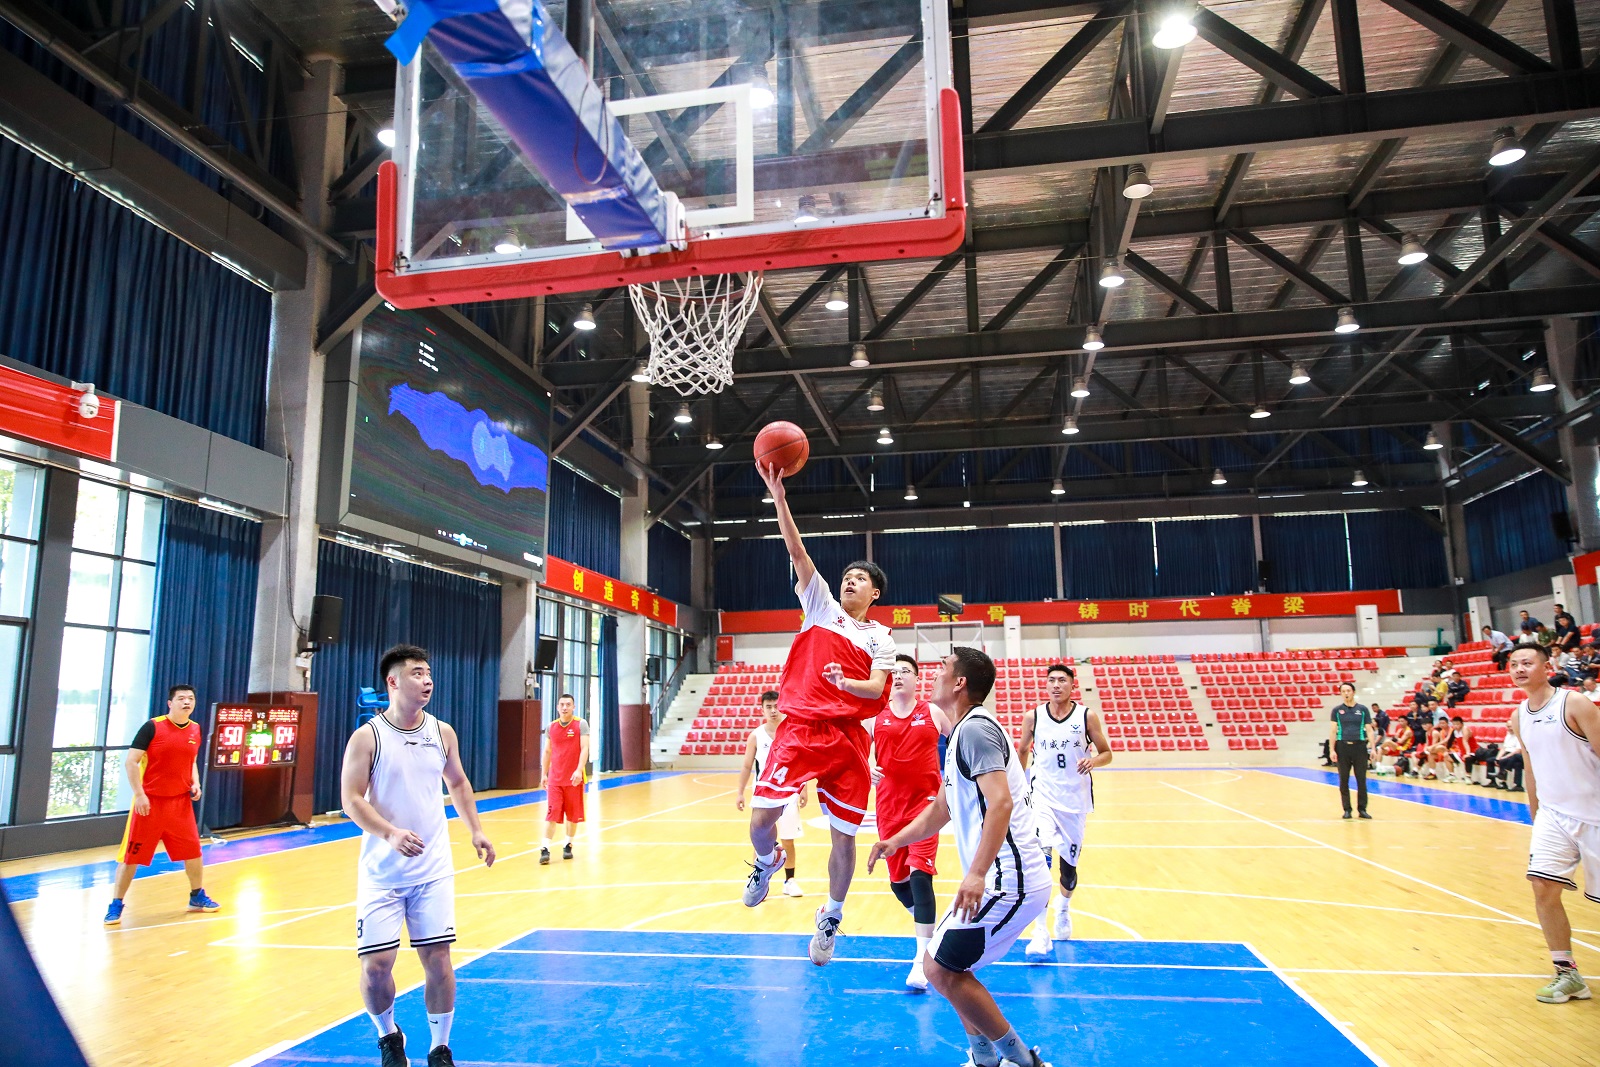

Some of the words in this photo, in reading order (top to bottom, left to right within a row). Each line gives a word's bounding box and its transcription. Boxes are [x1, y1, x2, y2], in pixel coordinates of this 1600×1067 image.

[1078, 596, 1305, 620] 铸时代脊梁
[224, 726, 243, 745] 50
[275, 726, 293, 745] 64
[247, 746, 266, 765] 20
[1057, 753, 1067, 769] 8
[767, 762, 789, 785] 14
[128, 841, 142, 855] 15
[1069, 843, 1078, 859] 8
